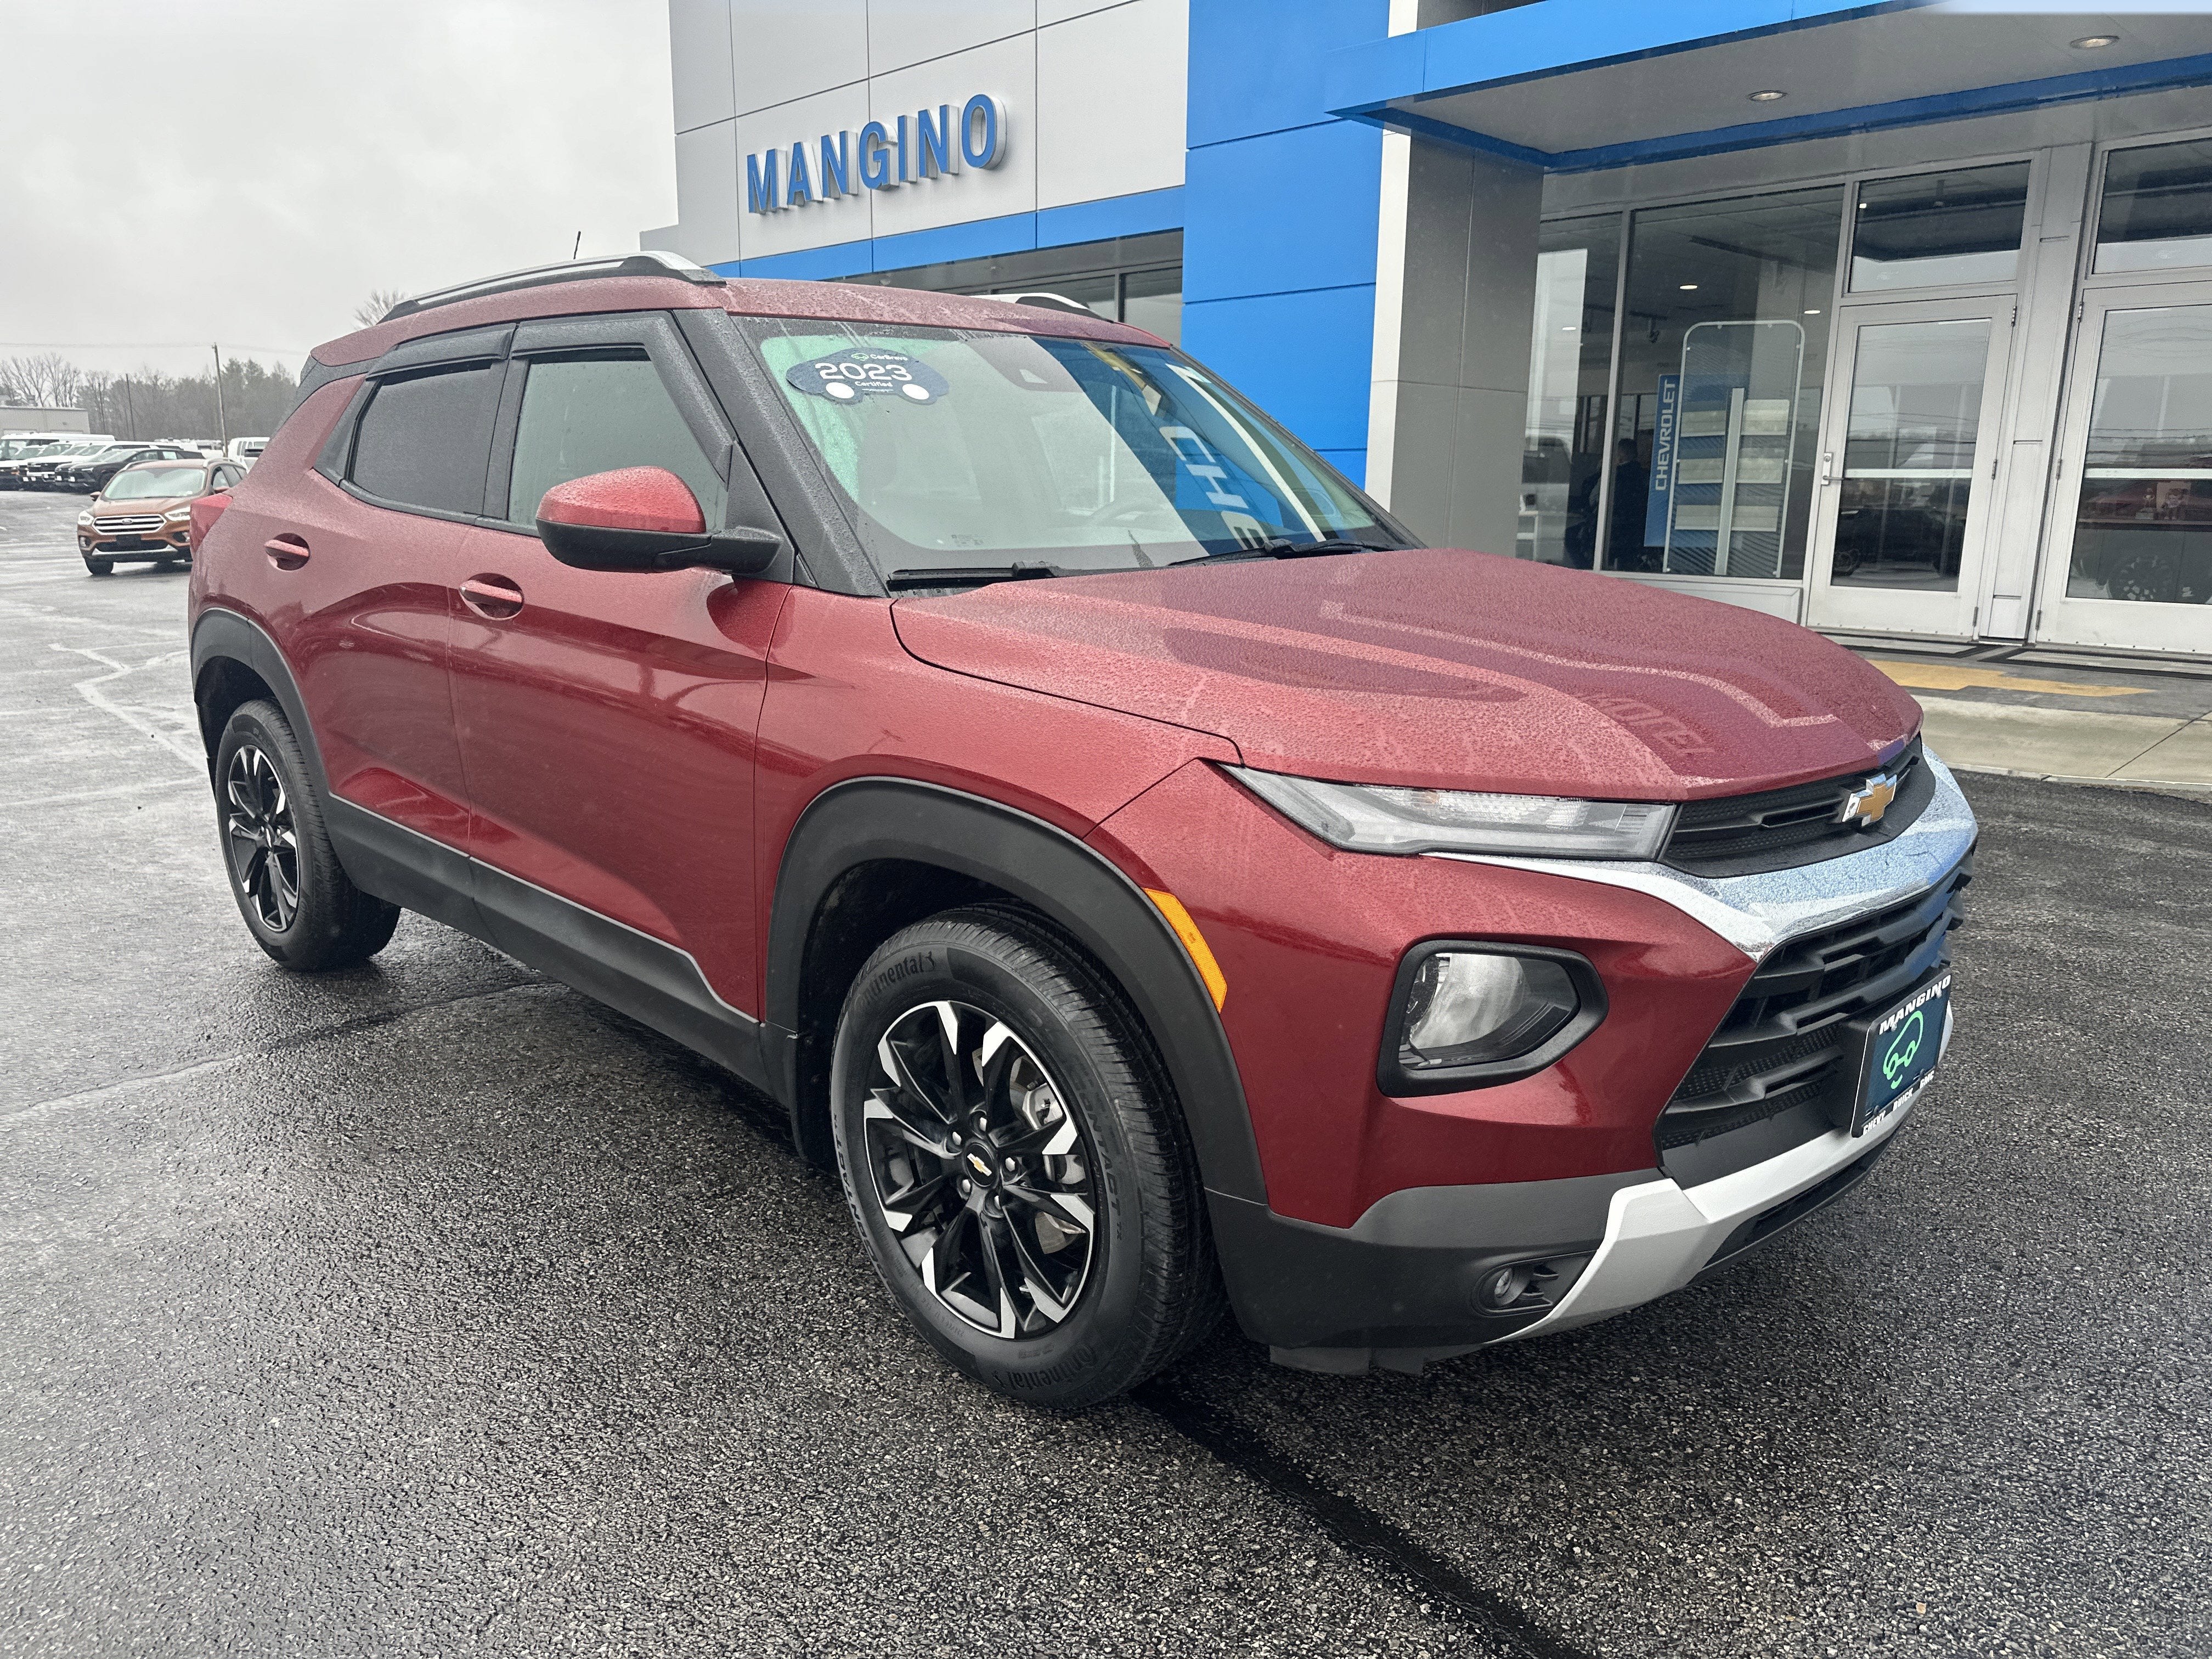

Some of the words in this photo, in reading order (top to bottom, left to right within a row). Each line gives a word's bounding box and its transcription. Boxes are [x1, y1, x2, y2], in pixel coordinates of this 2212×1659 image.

[747, 94, 1003, 214] MANGINO
[815, 362, 913, 381] 2023
[1655, 379, 1676, 490] CHEVROLET
[1879, 974, 1951, 1035] MANGINO
[1862, 1109, 1886, 1136] CHEVY
[1892, 1087, 1914, 1112] BUICK
[1919, 1070, 1935, 1089] GMC
